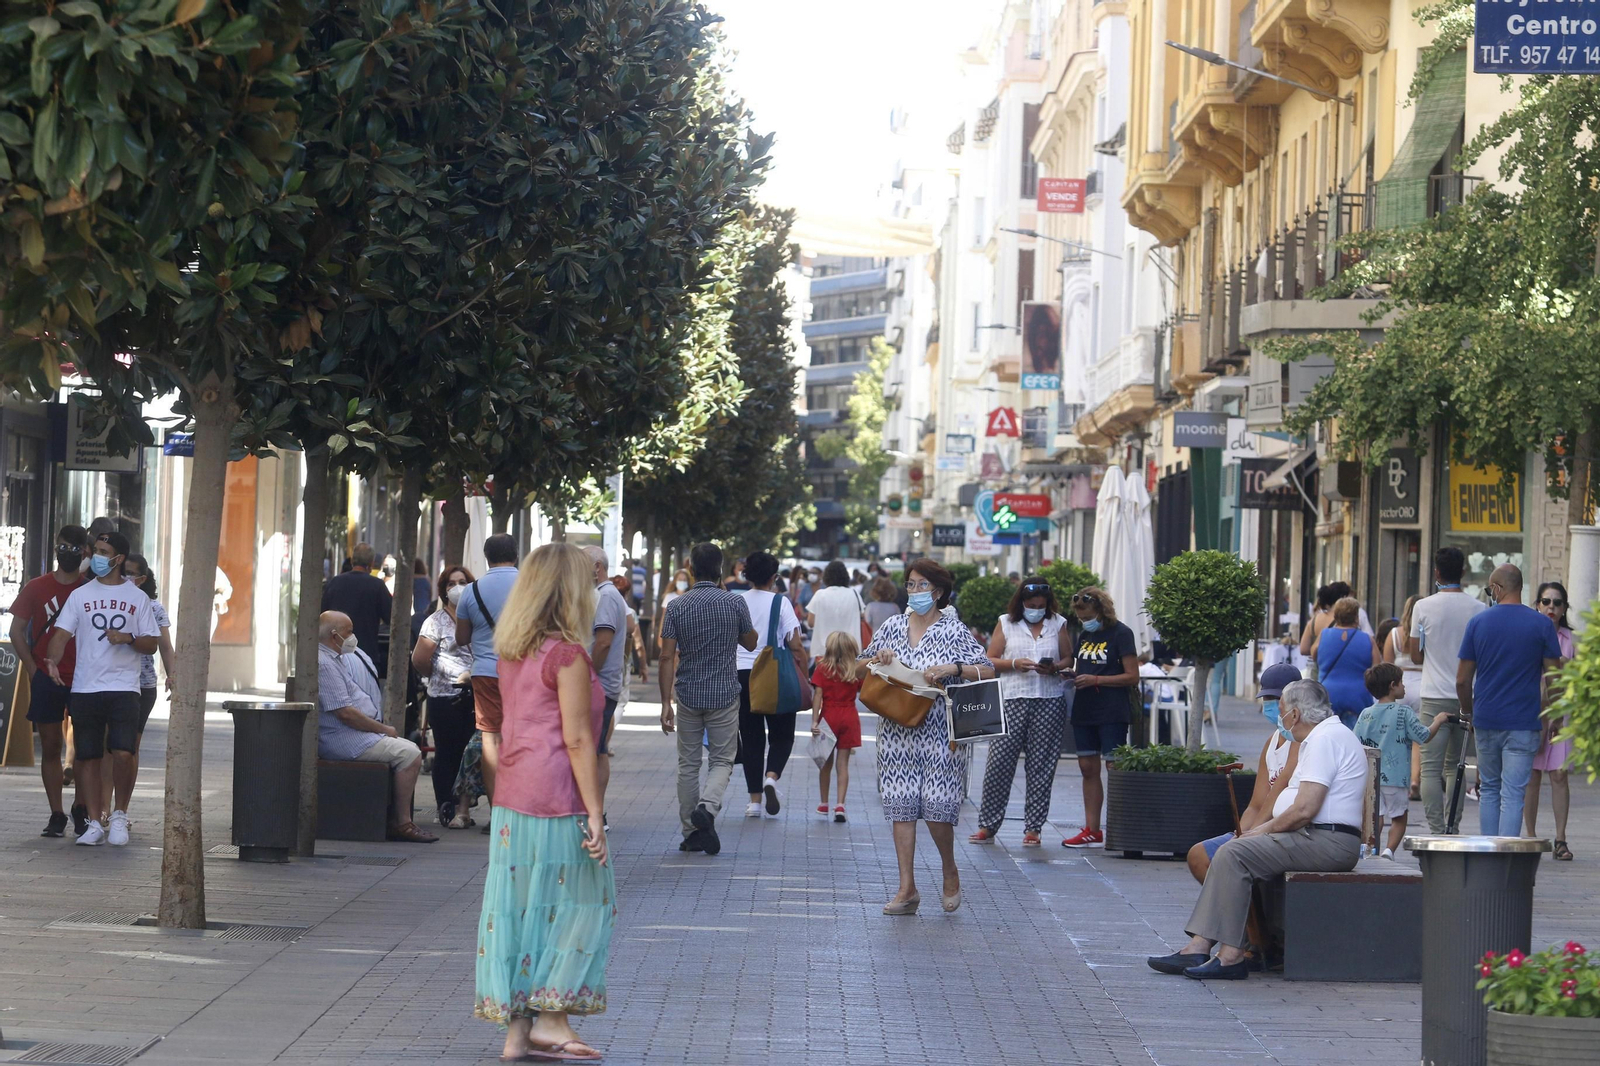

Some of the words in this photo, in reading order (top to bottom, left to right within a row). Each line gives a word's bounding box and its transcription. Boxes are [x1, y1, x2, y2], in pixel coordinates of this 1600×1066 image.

[1506, 14, 1597, 35] Centro
[1480, 45, 1513, 64] TLF.
[1520, 45, 1551, 64] 957
[1557, 46, 1577, 64] 47
[1583, 46, 1600, 64] 14
[1045, 192, 1078, 201] VENDE
[1175, 423, 1227, 436] moonë
[75, 457, 101, 465] Estado
[83, 599, 137, 616] SILBON
